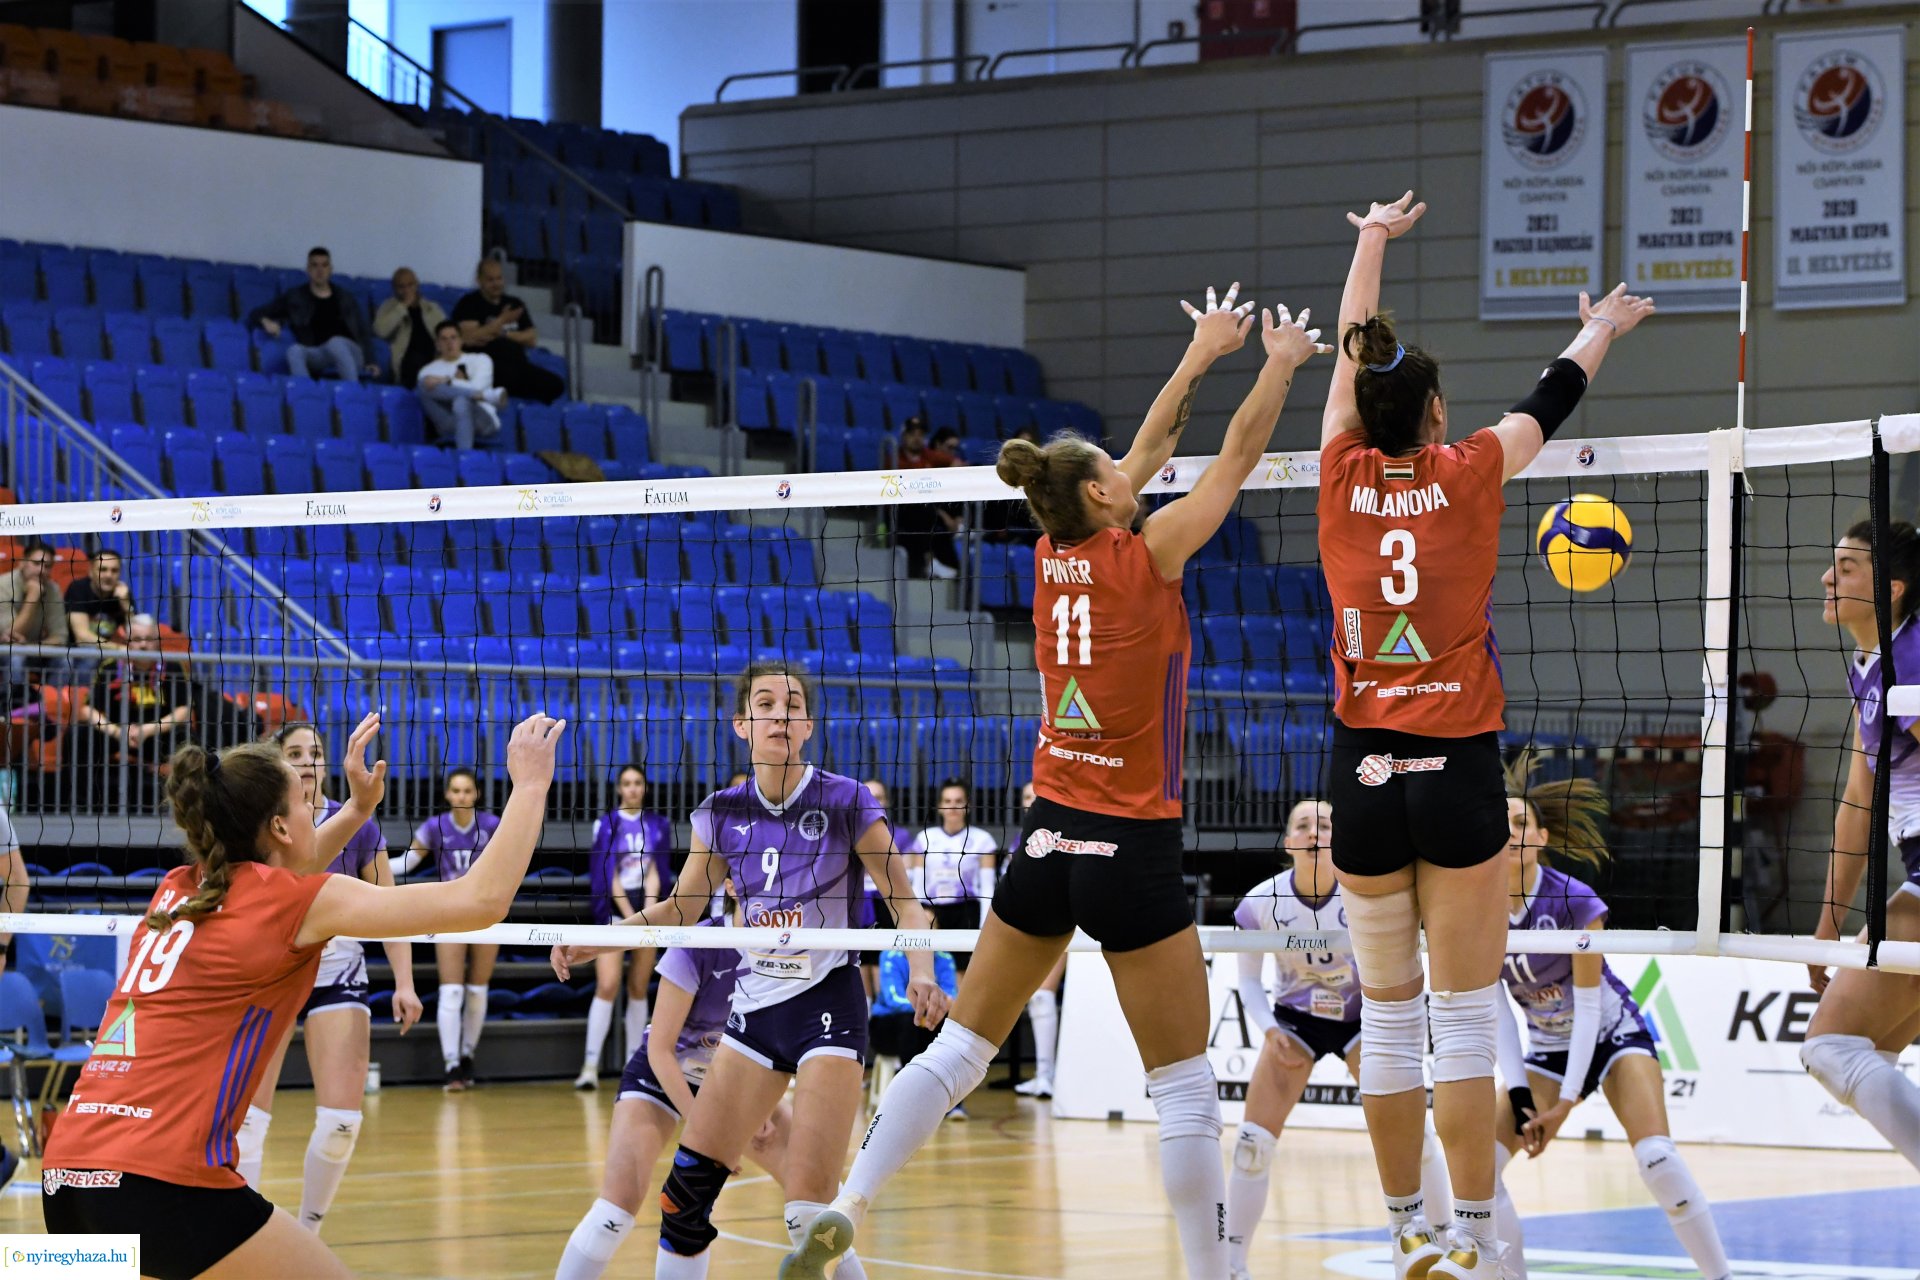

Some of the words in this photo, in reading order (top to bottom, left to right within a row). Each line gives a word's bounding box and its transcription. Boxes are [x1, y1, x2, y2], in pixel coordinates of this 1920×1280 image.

[1350, 482, 1449, 517] MILANOVA
[1042, 556, 1095, 585] PINTÉR
[1379, 528, 1419, 606] 3
[1052, 594, 1092, 665] 11
[1377, 682, 1461, 698] BESTRONG
[1049, 745, 1124, 768] BESTRONG
[761, 847, 779, 892] 9
[121, 920, 195, 993] 19
[821, 1012, 832, 1033] 9
[1728, 990, 1822, 1042] KE
[1671, 1079, 1697, 1097] 21
[76, 1102, 153, 1119] BESTRONG
